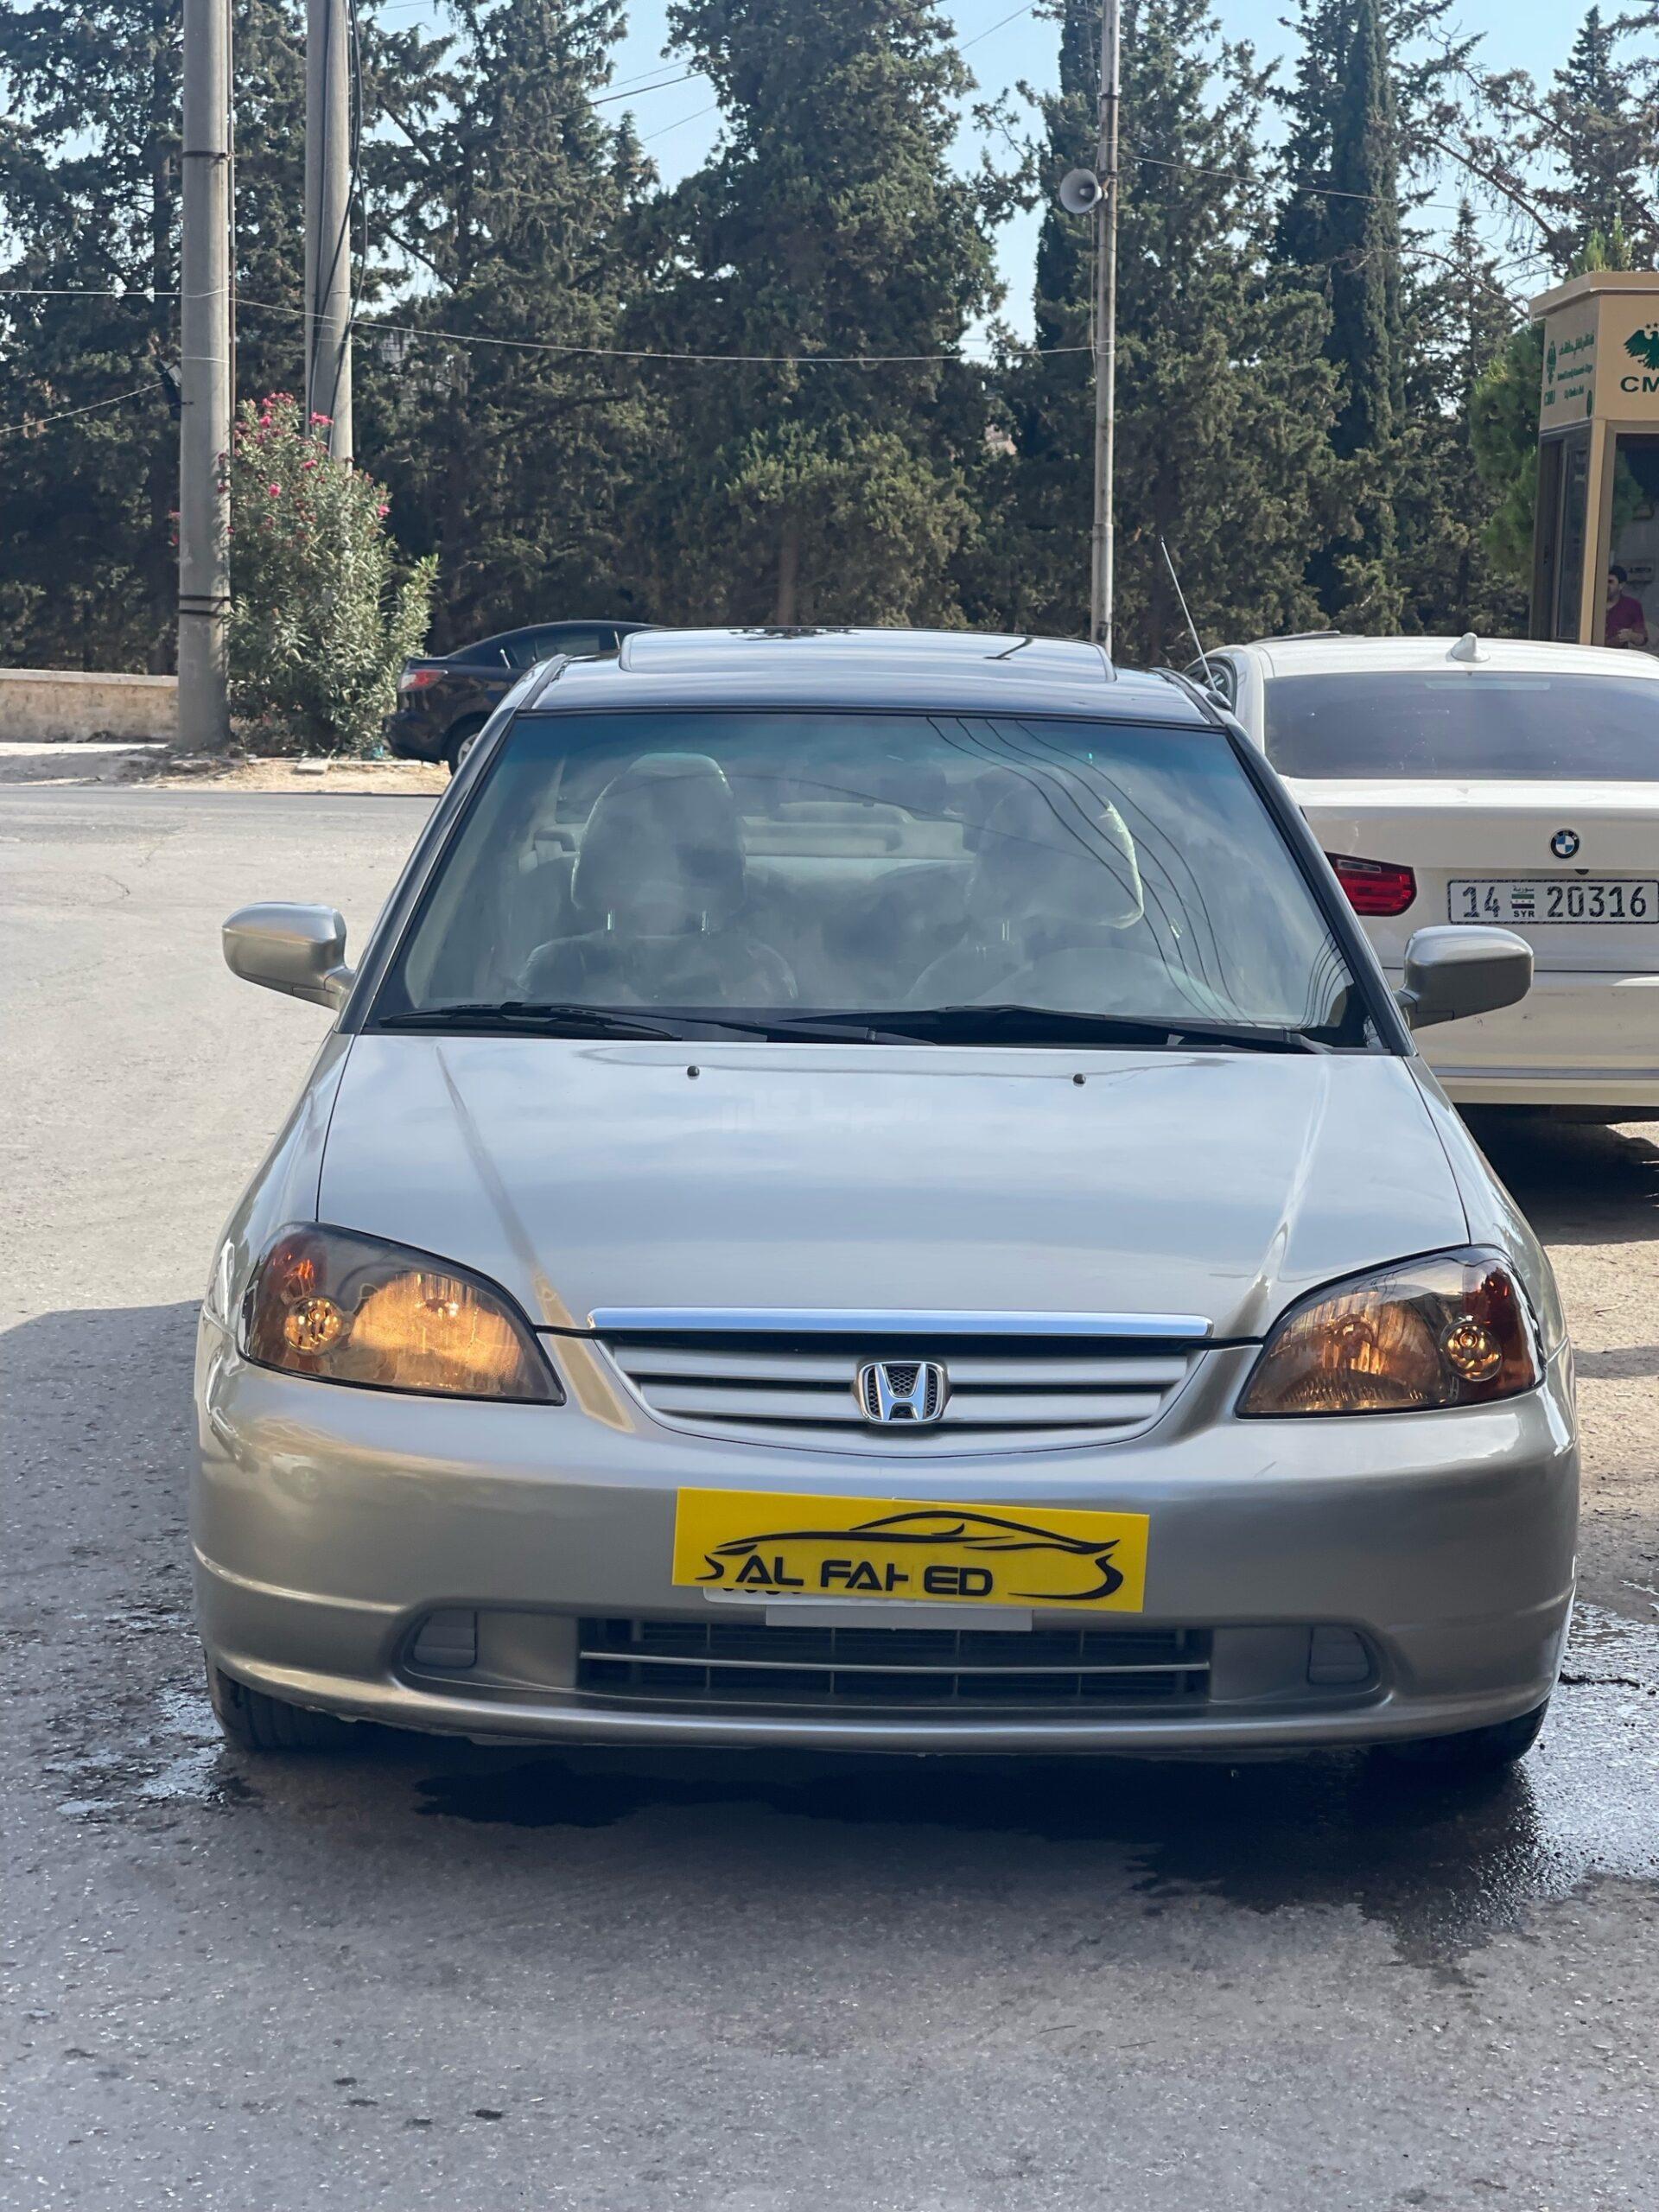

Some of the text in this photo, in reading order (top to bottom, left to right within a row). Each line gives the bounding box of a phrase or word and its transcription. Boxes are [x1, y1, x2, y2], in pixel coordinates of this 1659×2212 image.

[1462, 886, 1647, 918] 14 20316
[735, 1554, 804, 1587] AL
